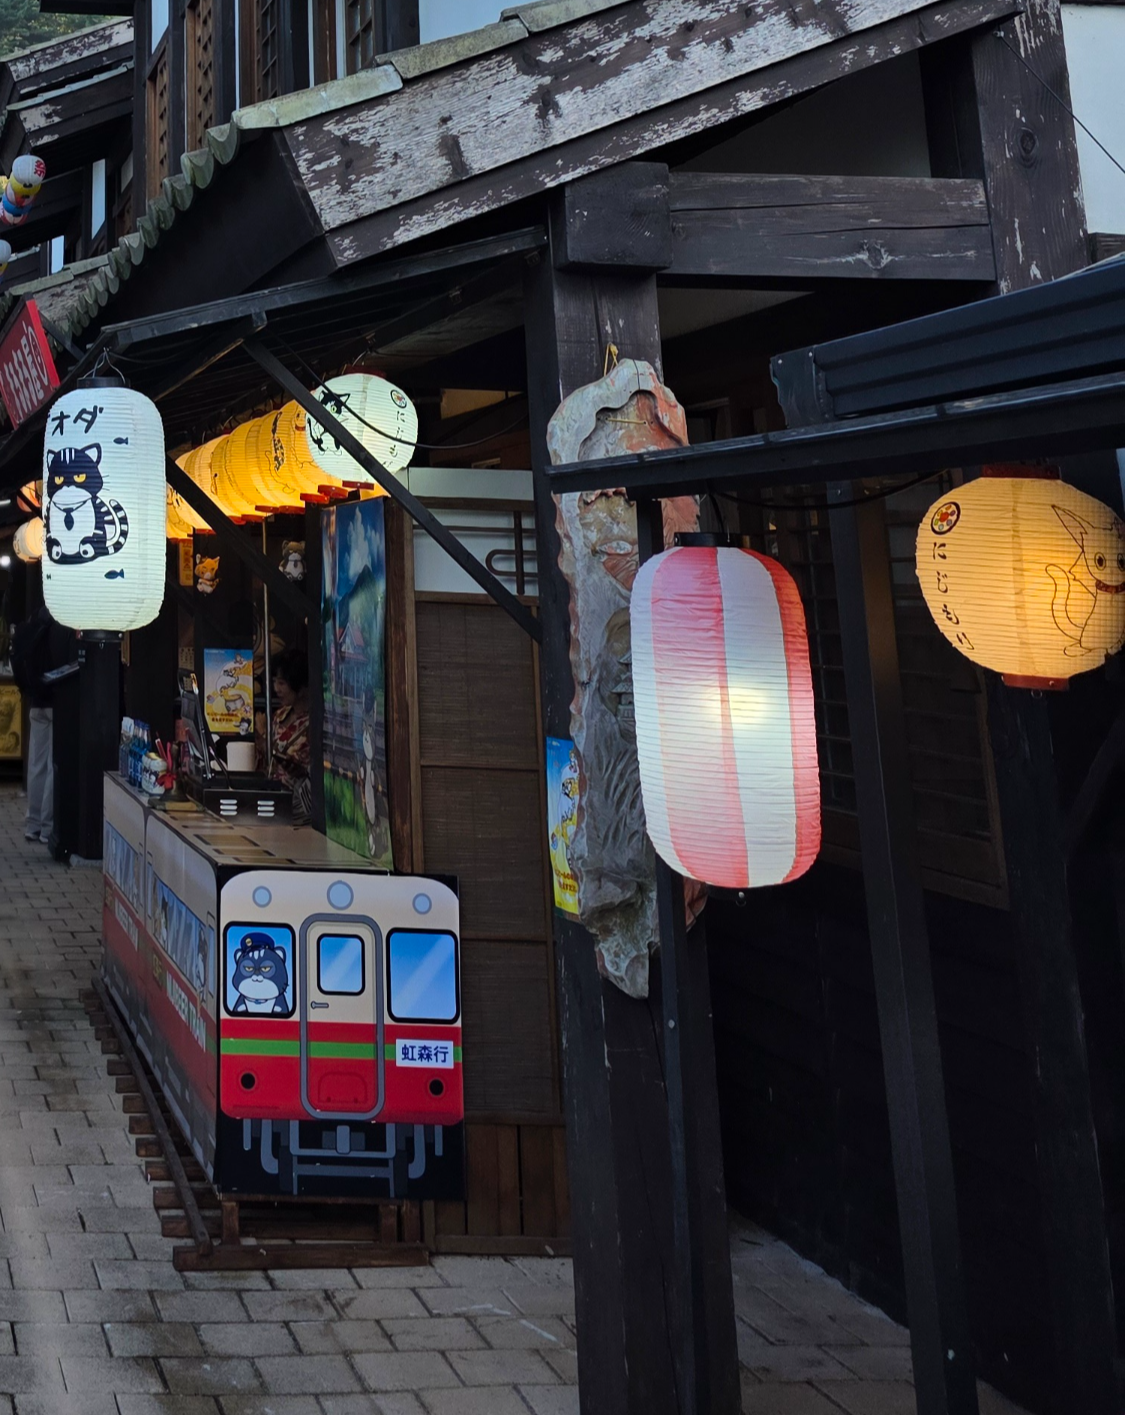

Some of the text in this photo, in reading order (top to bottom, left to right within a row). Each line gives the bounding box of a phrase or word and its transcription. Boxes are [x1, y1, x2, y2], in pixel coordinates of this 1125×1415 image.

[51, 404, 104, 437] オダ
[932, 541, 975, 651] にじもり
[401, 1044, 449, 1063] 虹森行
